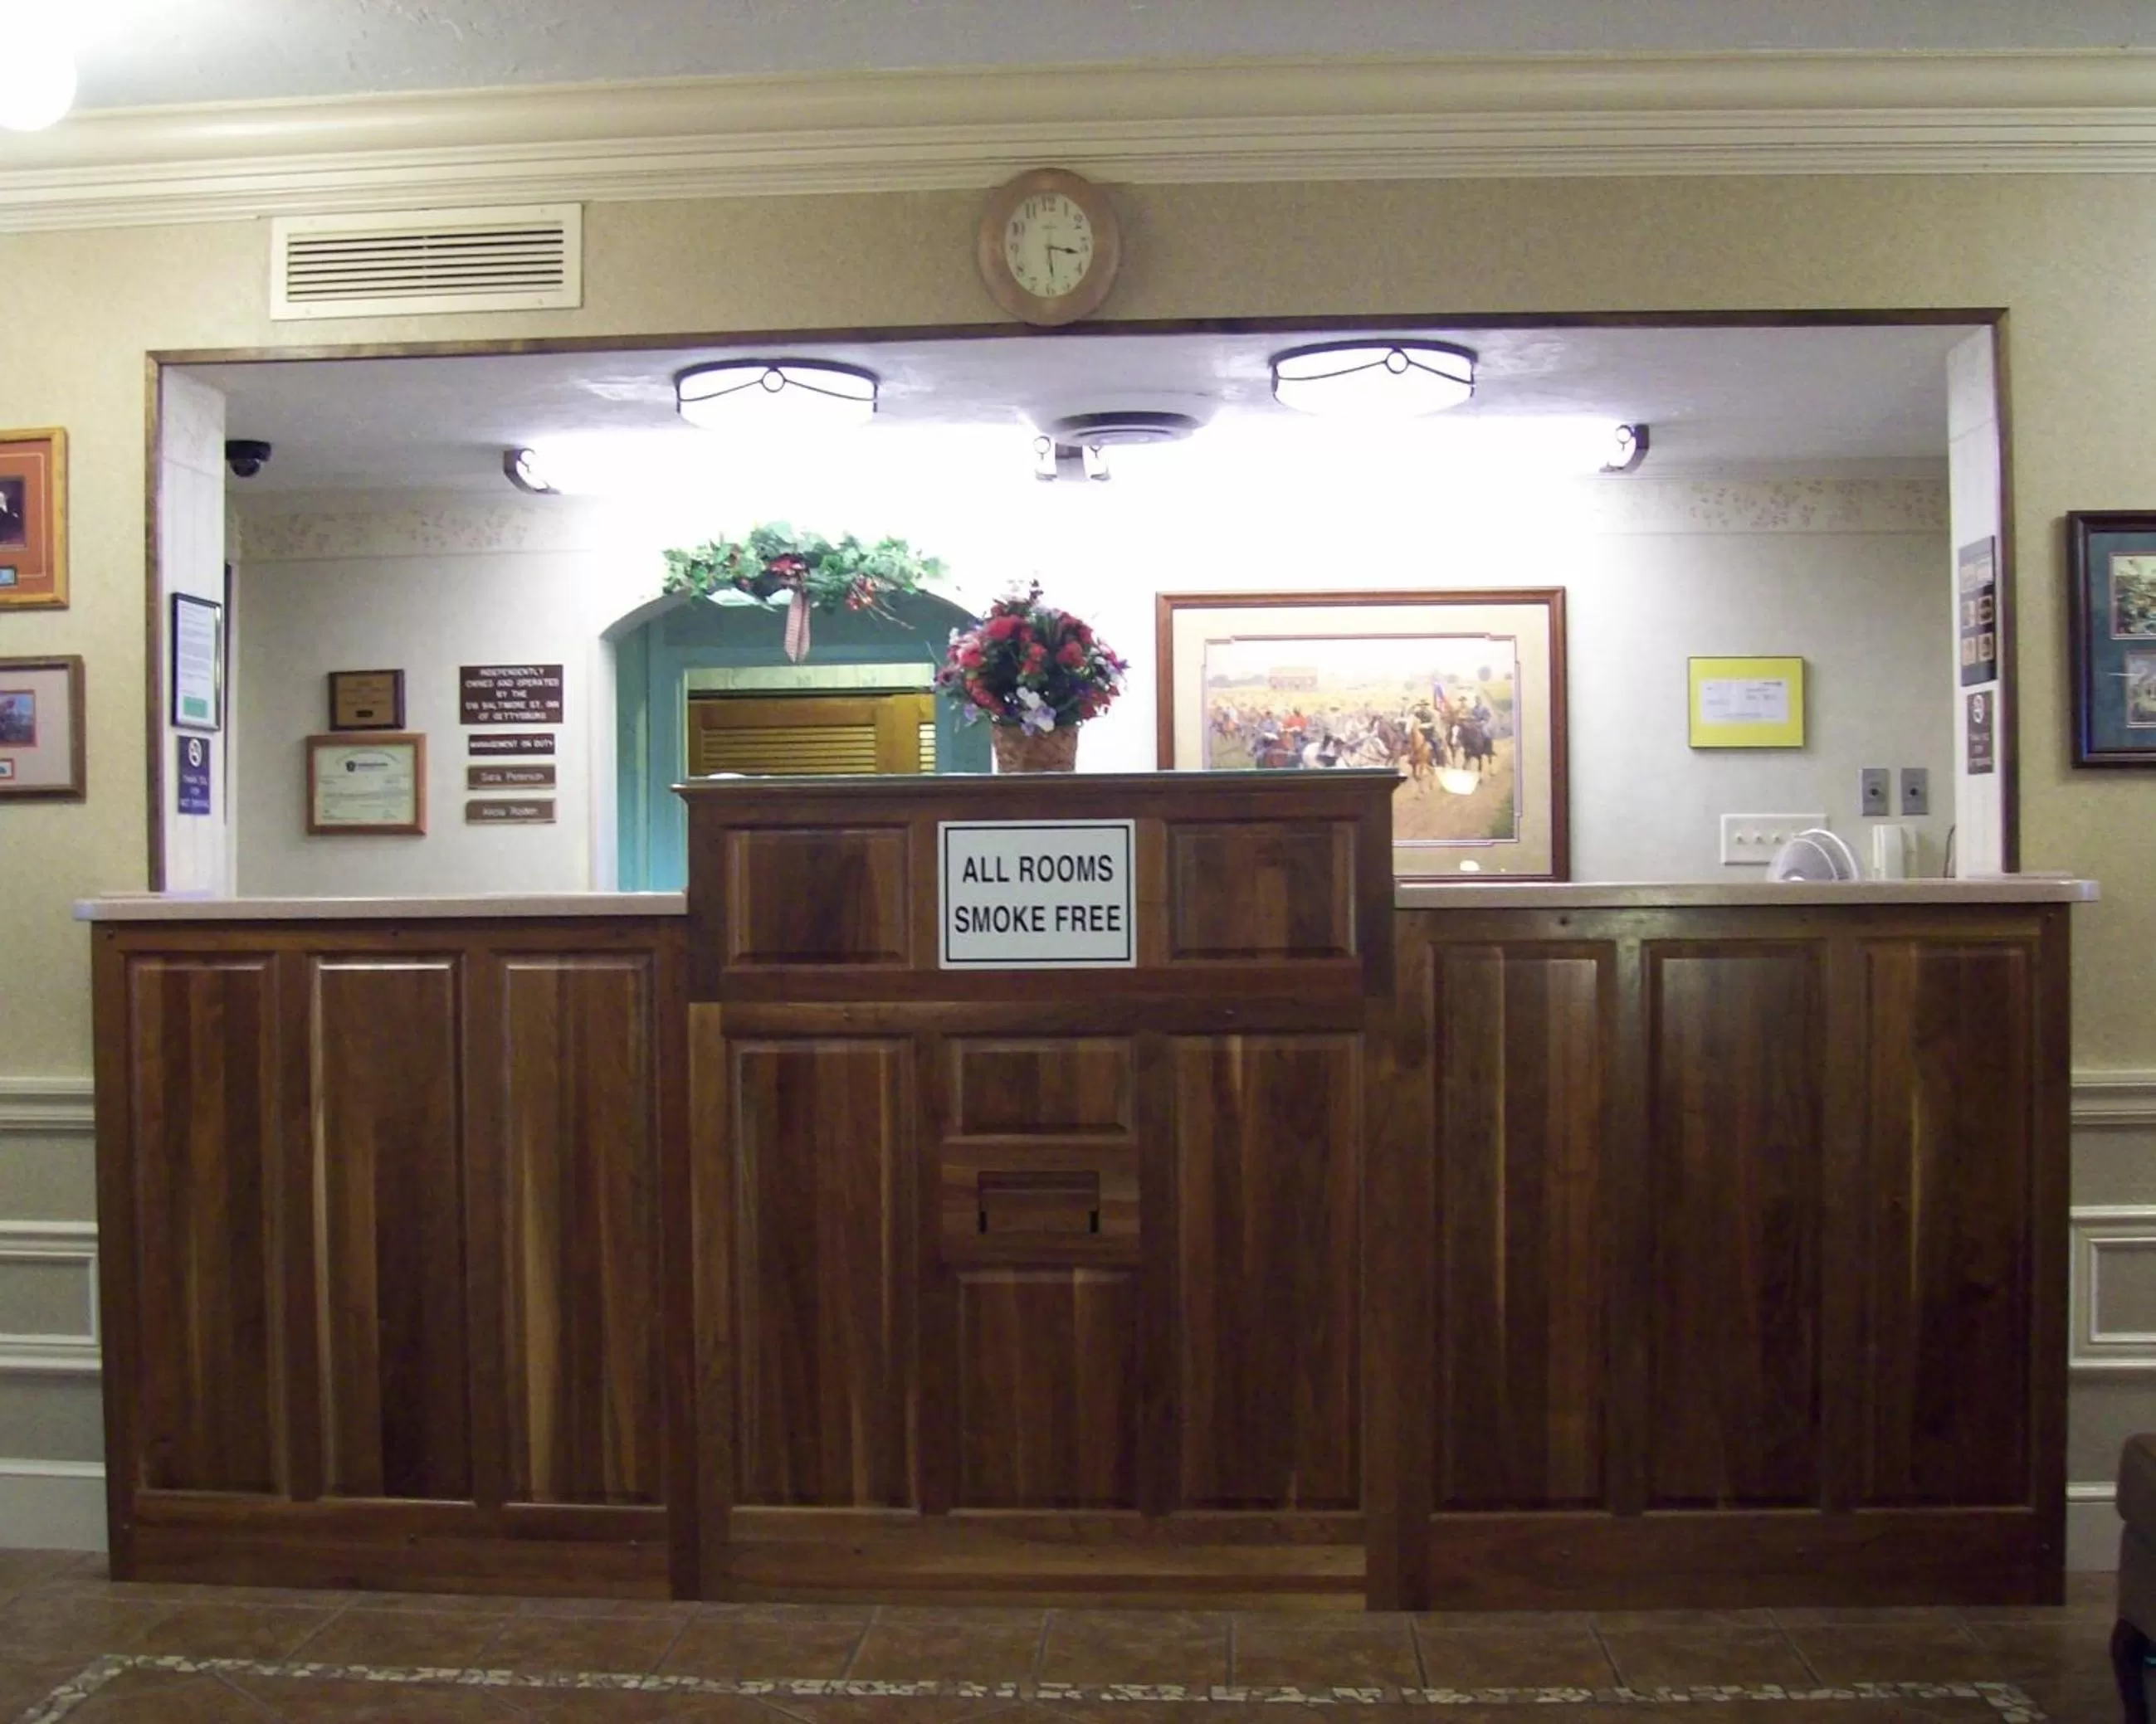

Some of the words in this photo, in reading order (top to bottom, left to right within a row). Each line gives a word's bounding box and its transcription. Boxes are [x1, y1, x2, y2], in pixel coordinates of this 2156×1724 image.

[963, 856, 1010, 883] ALL
[1019, 855, 1114, 883] ROOMS
[954, 905, 1046, 933] SMOKE
[1056, 905, 1122, 933] FREE
